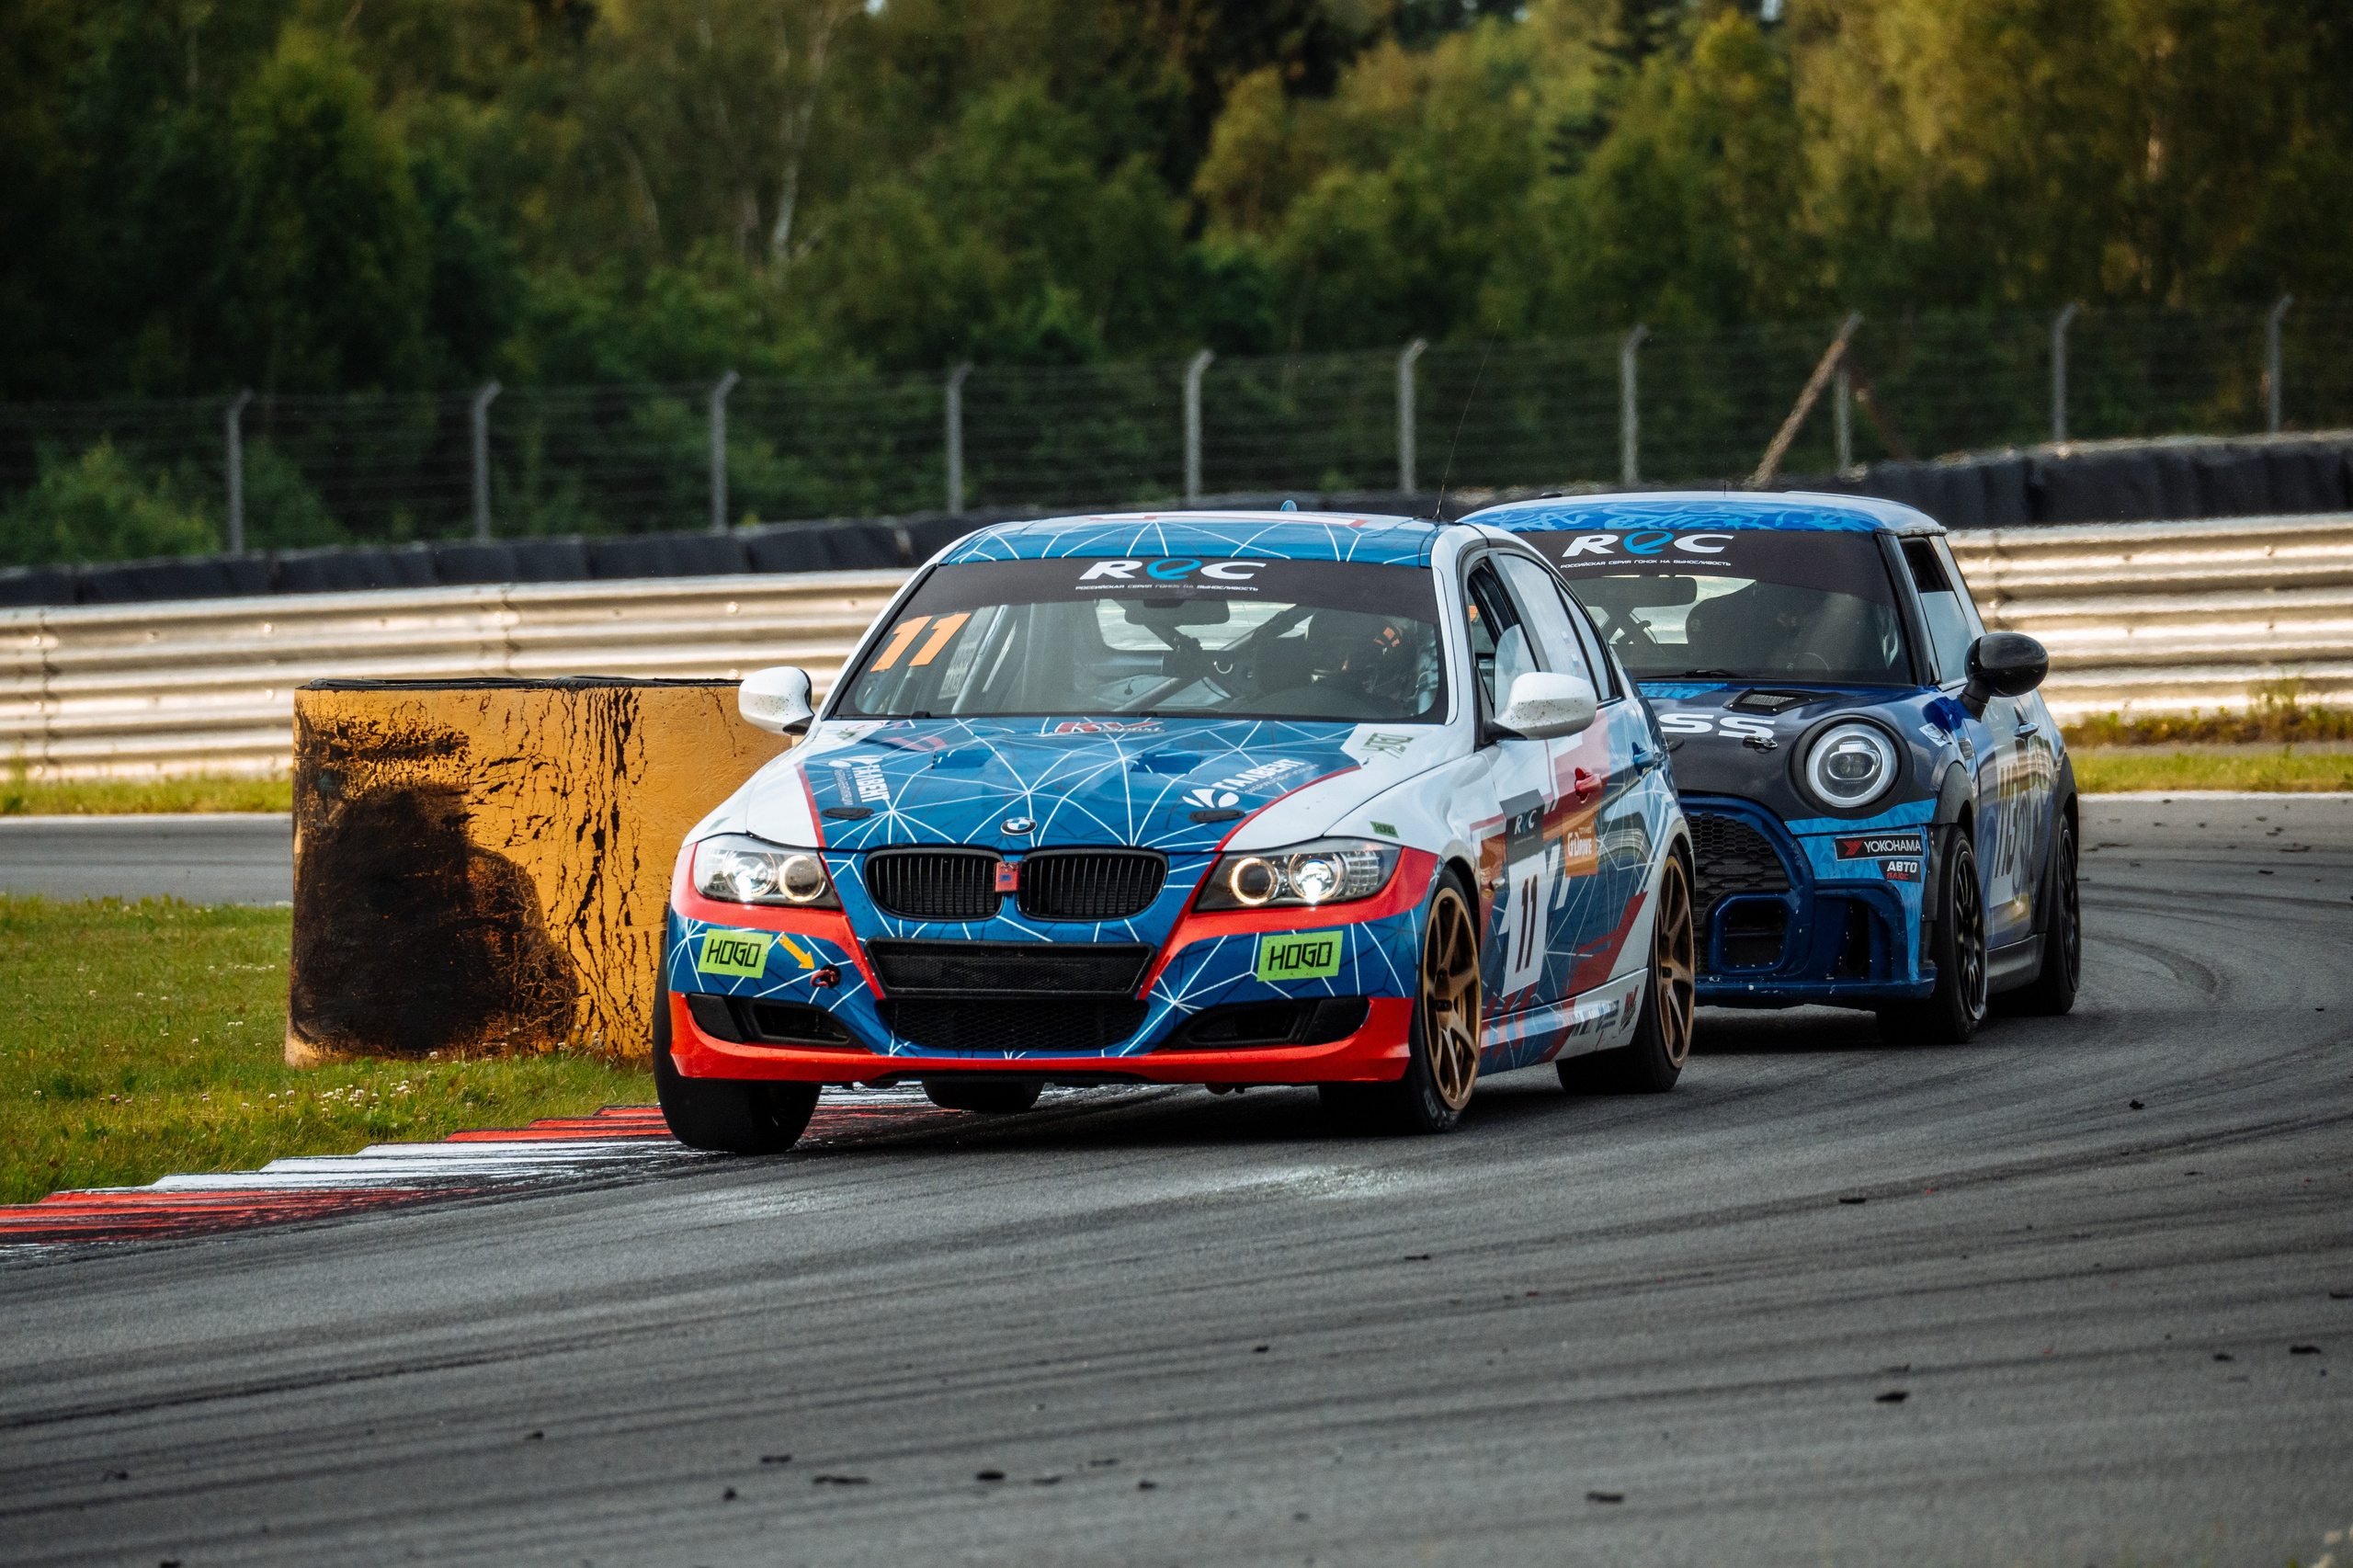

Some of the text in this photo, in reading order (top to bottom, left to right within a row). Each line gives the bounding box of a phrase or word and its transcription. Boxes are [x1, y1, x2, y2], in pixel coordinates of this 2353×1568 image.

[1560, 561, 1606, 569] РОССИЙСКАЯ
[870, 612, 972, 673] 11
[1211, 758, 1306, 791] ГАЛВЕНТ
[1863, 839, 1922, 853] YOKOHAMA
[1887, 860, 1918, 873] АВТО
[1887, 871, 1909, 881] ПЛЮС
[1515, 873, 1538, 973] 11
[706, 938, 762, 968] HOGO
[1267, 941, 1334, 971] HOGO
